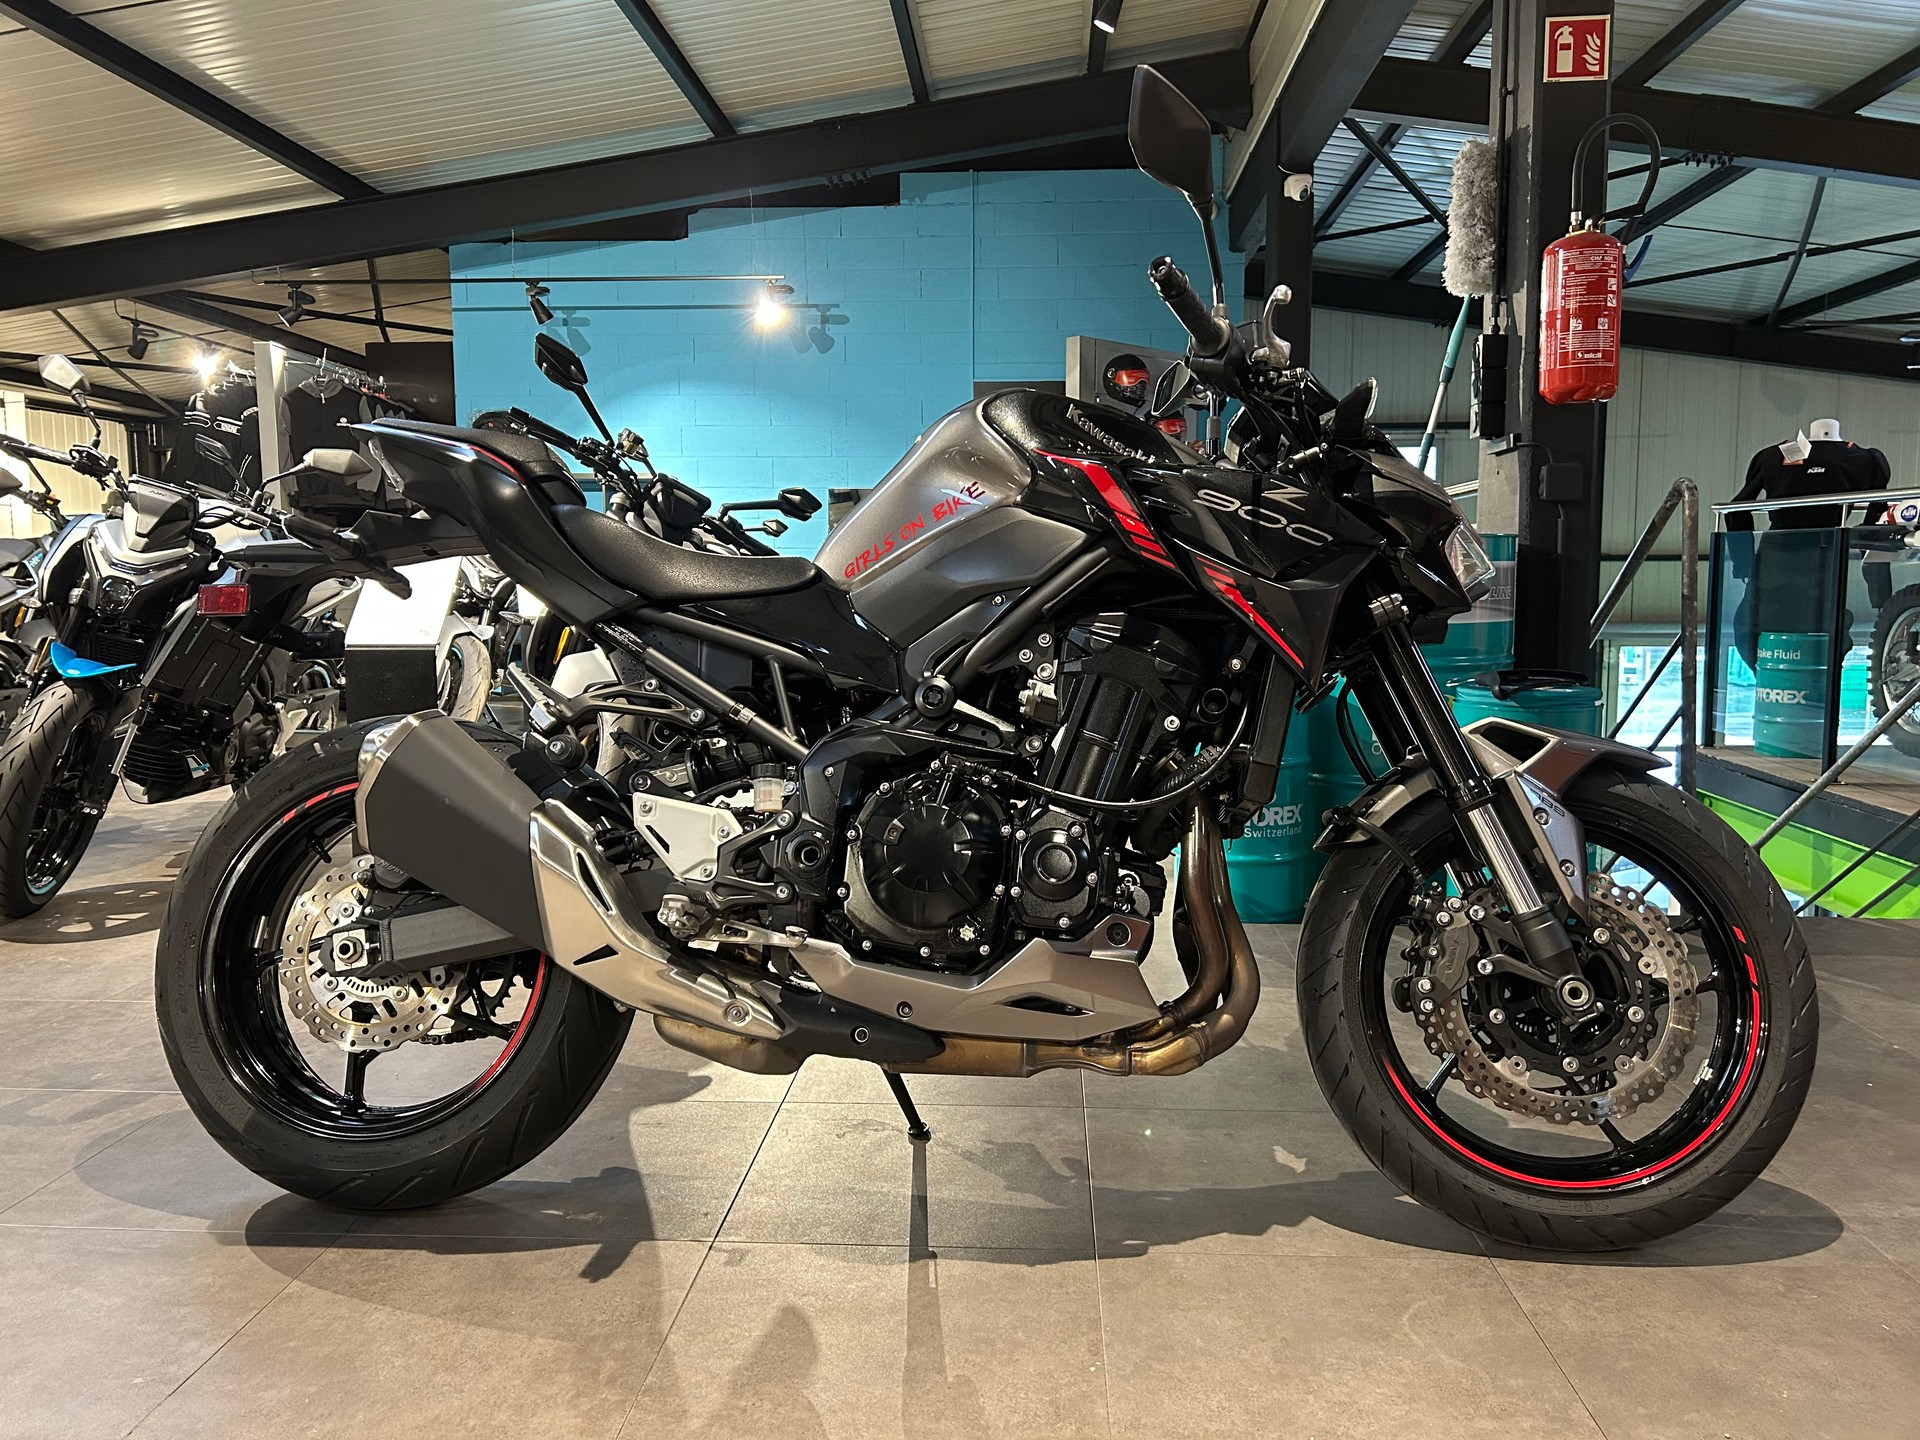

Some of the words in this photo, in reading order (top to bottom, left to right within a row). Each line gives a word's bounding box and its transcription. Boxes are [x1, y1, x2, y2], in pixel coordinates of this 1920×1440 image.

[1066, 403, 1156, 464] Kawasaki
[1807, 466, 1826, 474] KTM
[844, 531, 895, 578] GIRLS
[900, 512, 925, 541] ON
[931, 481, 986, 523] BIKE
[1192, 489, 1334, 547] 900
[1774, 649, 1801, 660] Fluid
